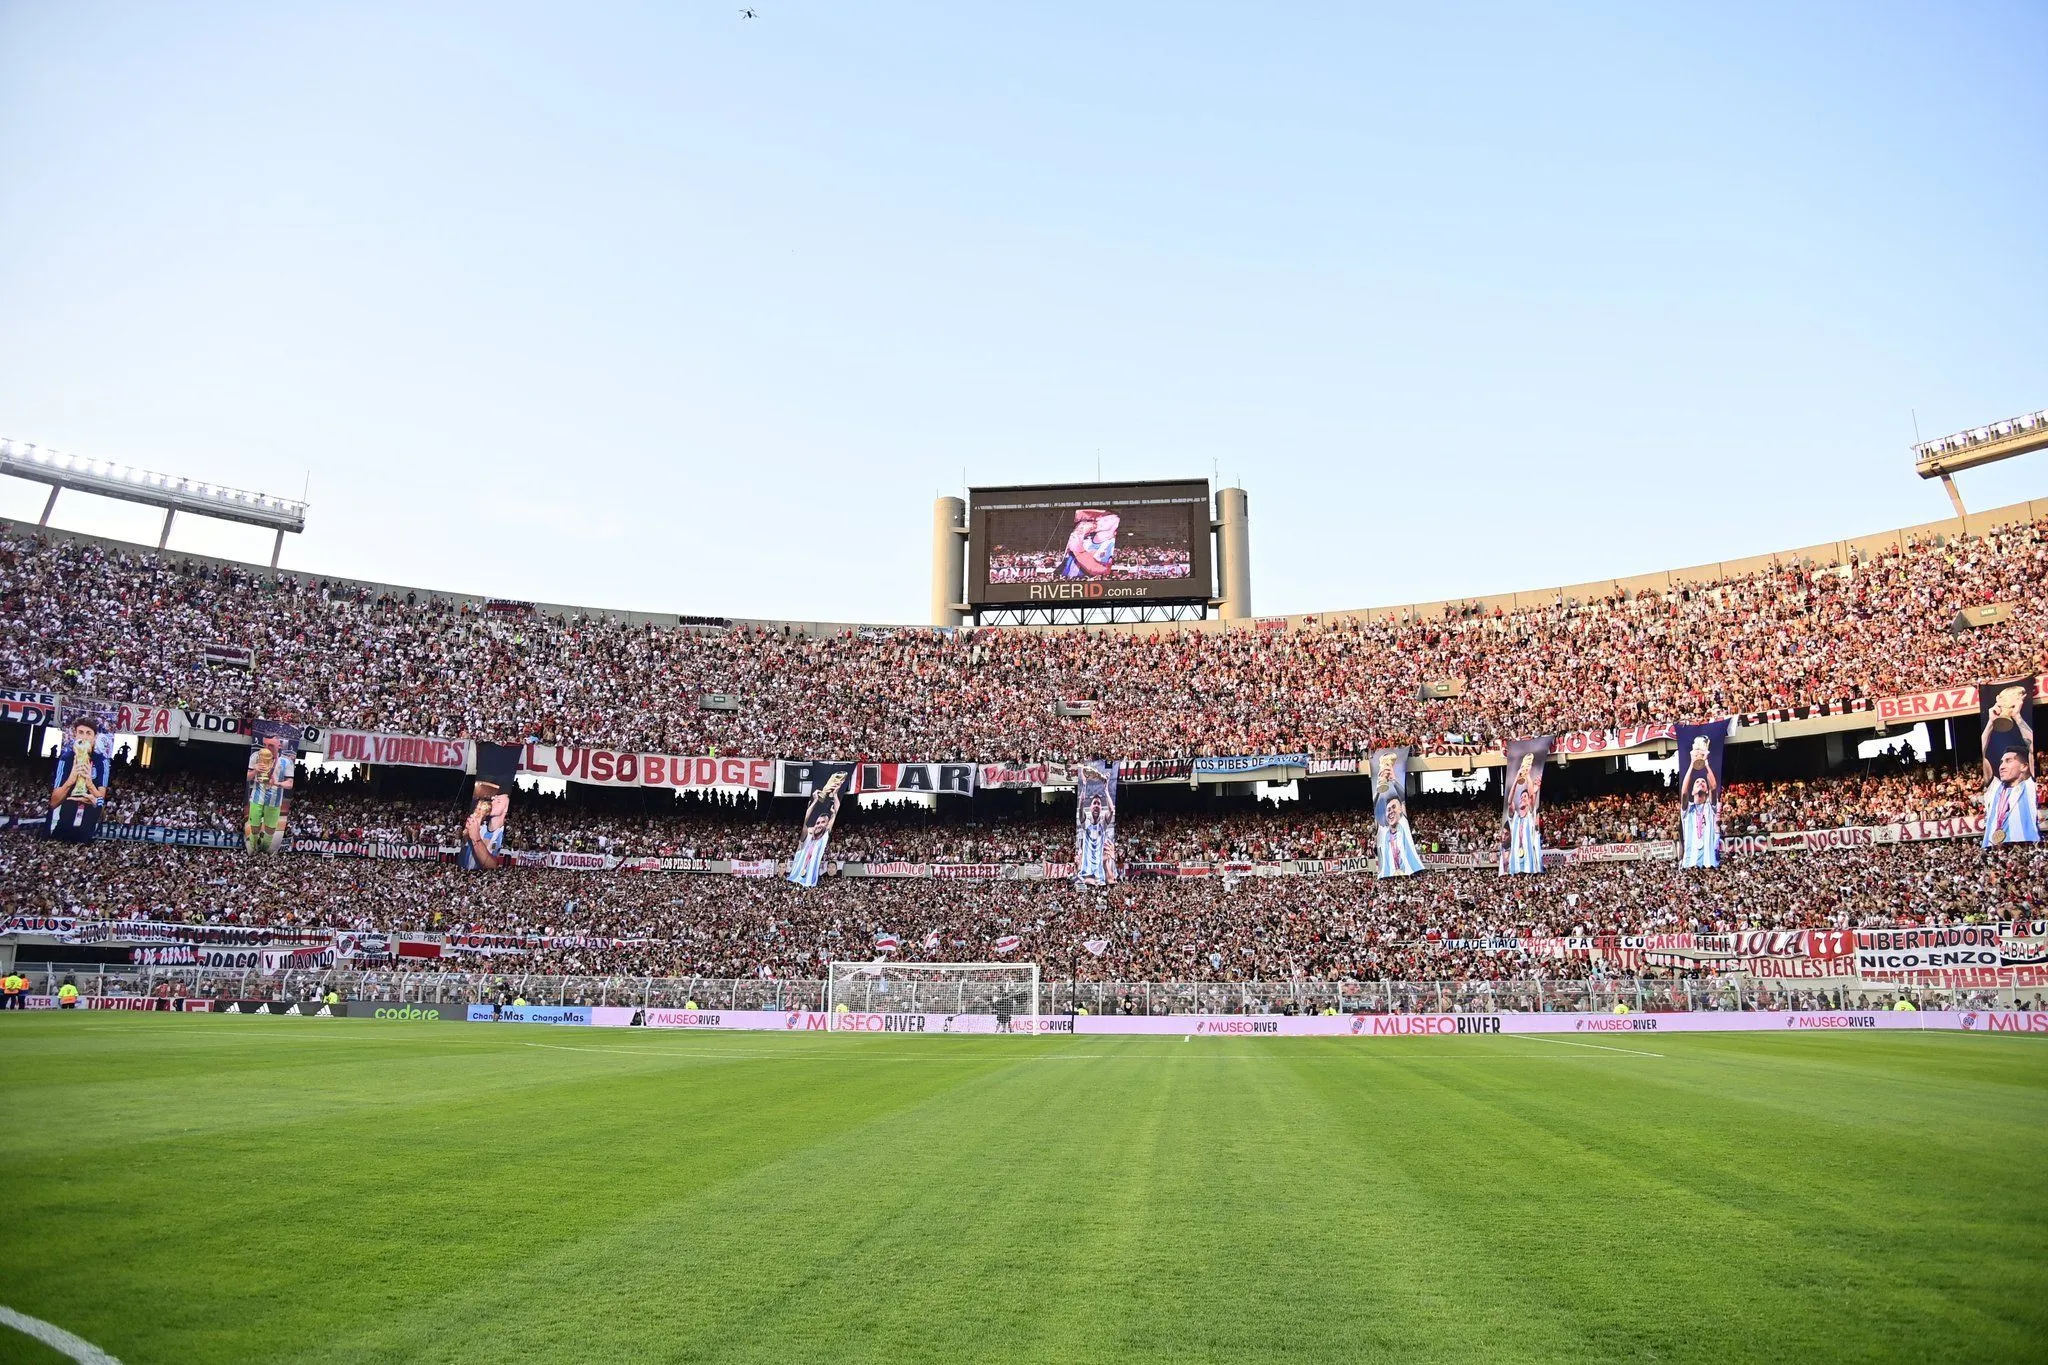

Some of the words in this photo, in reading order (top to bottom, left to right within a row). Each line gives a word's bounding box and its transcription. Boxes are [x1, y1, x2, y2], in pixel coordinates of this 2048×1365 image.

[1748, 697, 1868, 726] SOLANO
[328, 733, 464, 767] POLVORINES
[556, 747, 638, 782] VISO
[1195, 760, 1214, 770] LOS
[1218, 759, 1248, 769] PIBES
[1252, 758, 1264, 767] DE
[644, 757, 770, 788] BUDGE
[783, 763, 972, 793] PLAR
[1806, 828, 1872, 850] NOGUES
[560, 856, 604, 868] DORREGO
[661, 858, 672, 869] LOS
[1297, 860, 1323, 874] VILLA
[1340, 857, 1368, 871] MAYO
[116, 923, 173, 938] MARTINEZ
[424, 934, 441, 943] PIBES
[1646, 934, 1692, 949] GARIN
[1734, 931, 1807, 956] LOLA
[1813, 932, 1844, 954] 77
[1857, 928, 1996, 950] LIBERTADOR
[160, 946, 195, 965] ABRIL
[1861, 951, 1997, 968] NICO-ENZO
[25, 997, 51, 1006] LTER
[375, 1004, 439, 1020] codere
[473, 1010, 524, 1021] ChanoMas
[532, 1012, 584, 1023] ChangoMas
[657, 1013, 720, 1026] MUSEORIVER
[807, 1014, 925, 1032] MUSEORIVER
[1010, 1020, 1073, 1031] MUSORIVER
[1209, 1022, 1277, 1033] MUSEORIVER
[1374, 1017, 1500, 1034] MUSEORIVER
[1588, 1019, 1657, 1030] MUSEORIVER
[1800, 1016, 1876, 1028] MUSEORIVER
